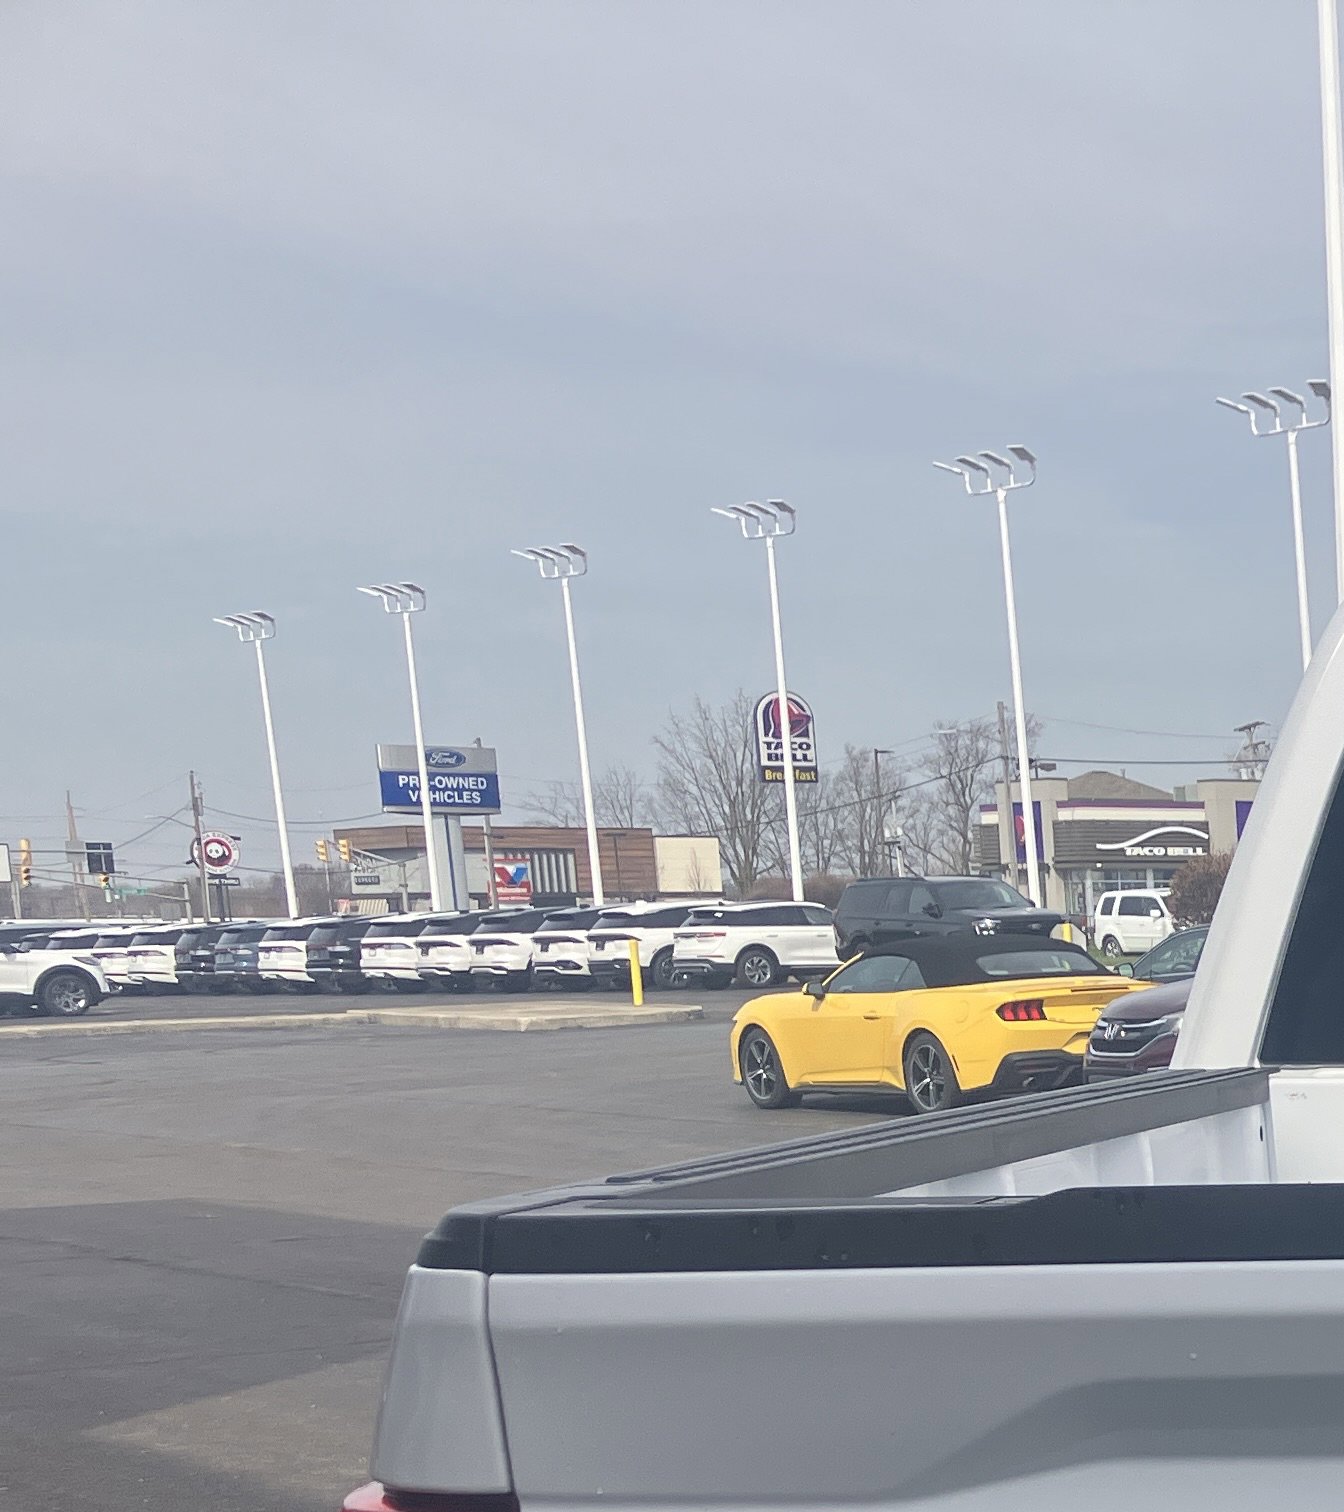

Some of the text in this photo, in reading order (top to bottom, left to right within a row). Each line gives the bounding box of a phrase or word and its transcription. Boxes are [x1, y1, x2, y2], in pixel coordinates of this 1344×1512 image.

[429, 752, 458, 764] Ford
[398, 775, 488, 790] PR-OWNED
[408, 790, 482, 804] VHICLES
[1124, 846, 1207, 856] TACO BELL
